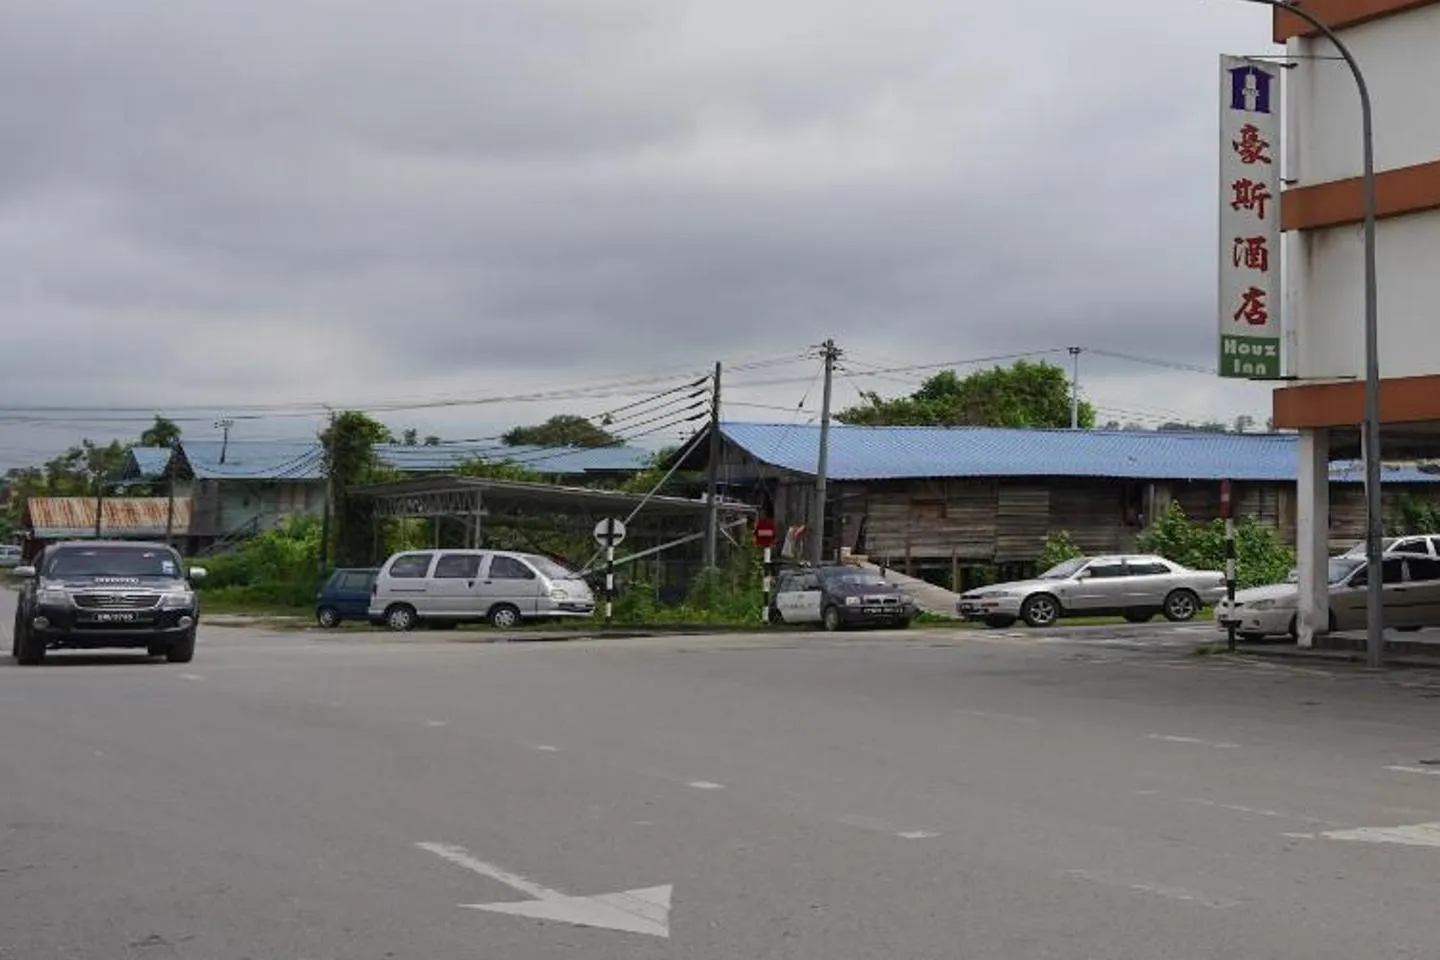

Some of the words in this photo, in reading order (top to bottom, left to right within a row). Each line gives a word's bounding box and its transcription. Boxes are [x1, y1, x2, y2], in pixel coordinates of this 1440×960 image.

[1230, 123, 1272, 325] 豪斯酒店
[1224, 339, 1277, 357] Houz
[1233, 359, 1267, 376] Inn
